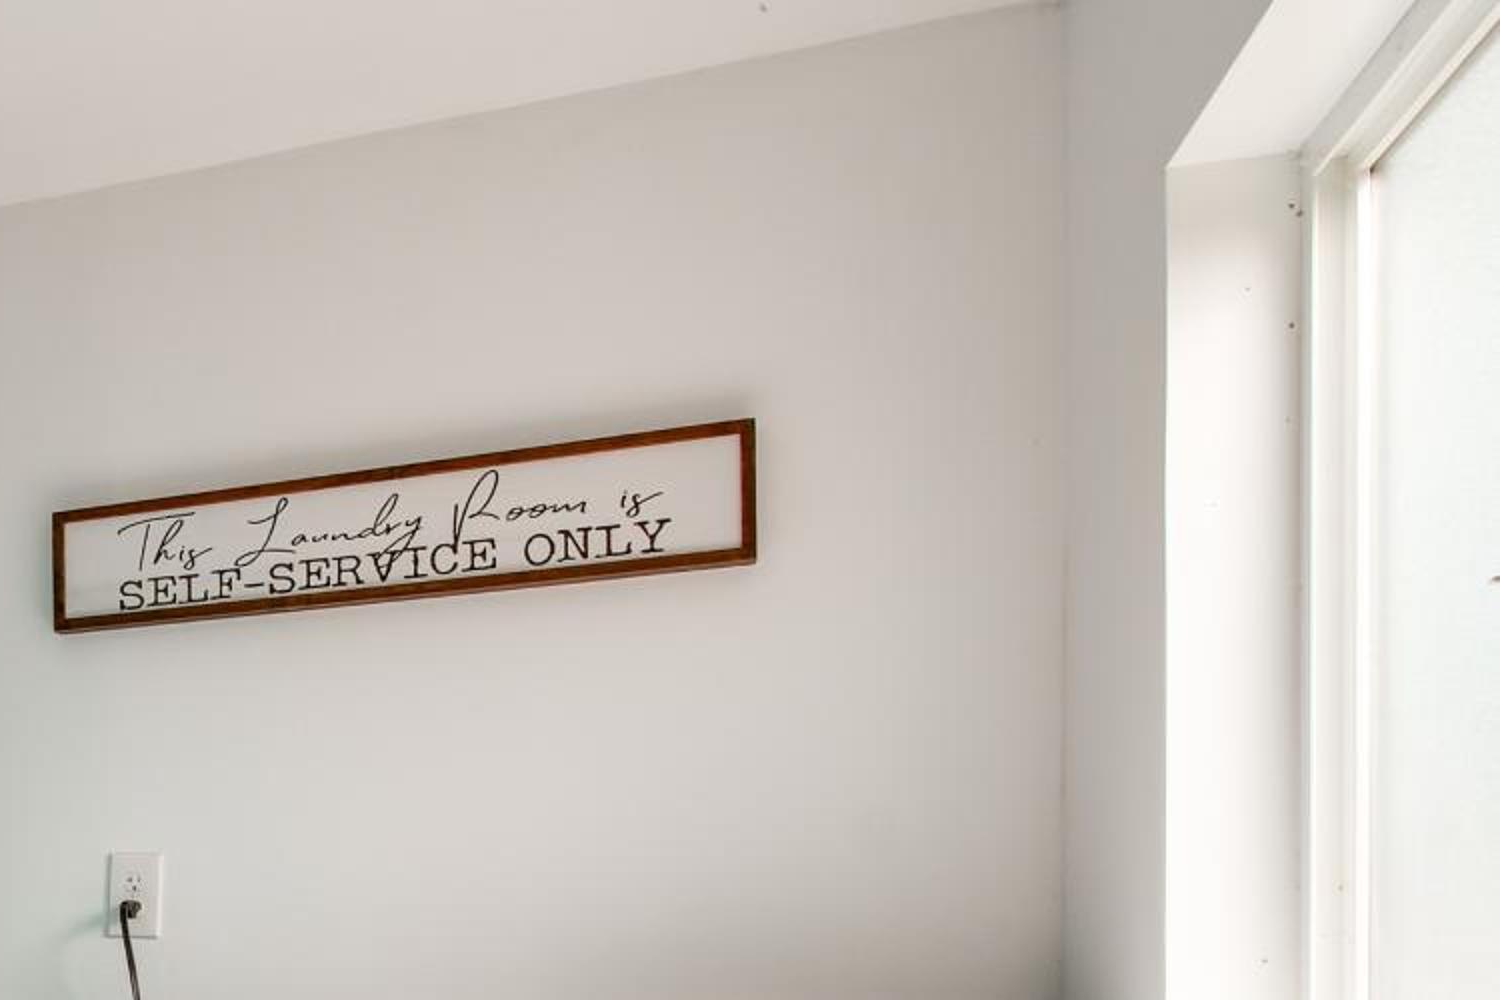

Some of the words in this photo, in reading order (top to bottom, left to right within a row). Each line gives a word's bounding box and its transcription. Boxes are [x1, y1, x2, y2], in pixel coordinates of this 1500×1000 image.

[117, 511, 213, 572] This
[234, 492, 423, 562] Laundry
[452, 469, 587, 556] Room
[619, 489, 665, 518] is
[118, 537, 498, 611] SELF-SERVICE
[523, 517, 672, 567] ONLY
